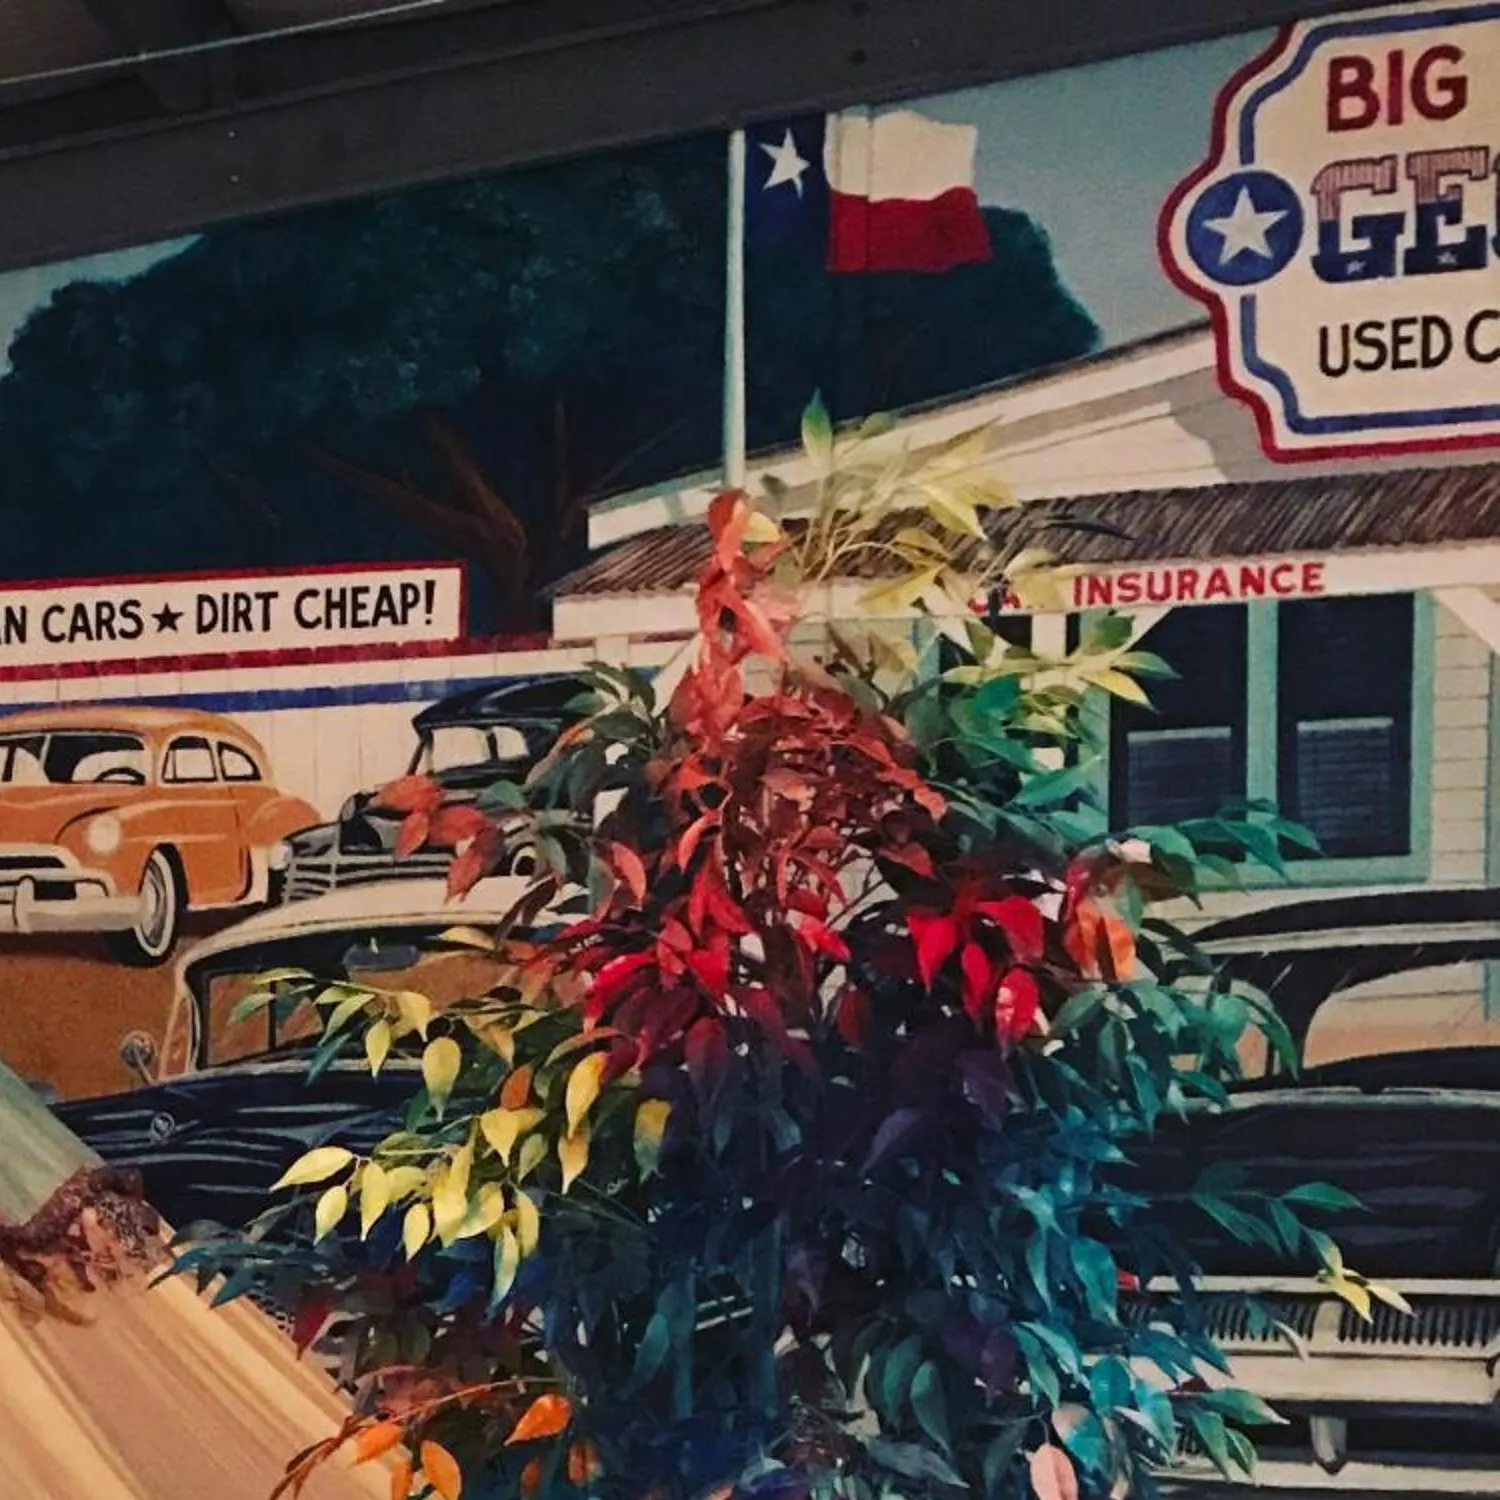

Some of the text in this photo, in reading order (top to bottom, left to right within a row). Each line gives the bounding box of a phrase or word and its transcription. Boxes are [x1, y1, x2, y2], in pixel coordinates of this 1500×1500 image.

[1326, 44, 1468, 132] BIG
[1310, 145, 1500, 283] GE
[1318, 315, 1453, 378] USED
[41, 599, 145, 641] CARS
[195, 590, 279, 635] DIRT
[293, 579, 437, 630] CHEAP!
[1073, 562, 1326, 607] INSURANCE
